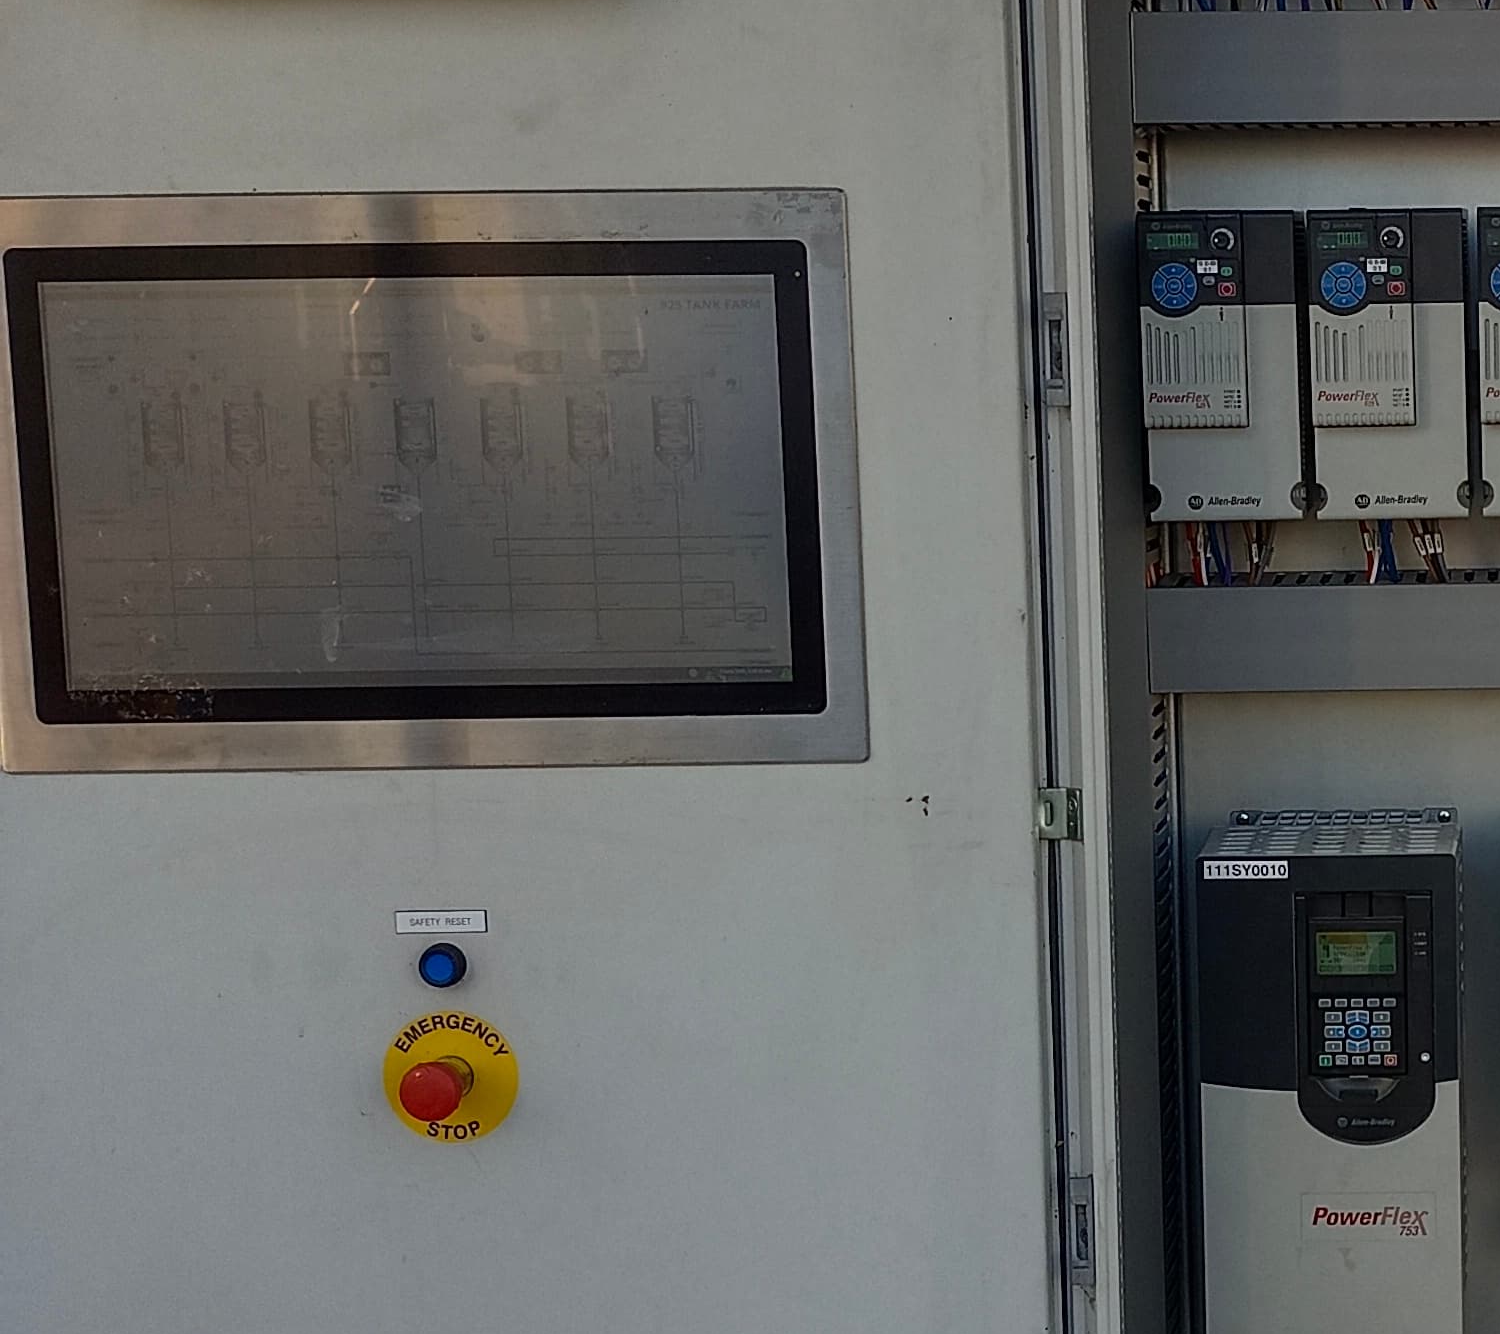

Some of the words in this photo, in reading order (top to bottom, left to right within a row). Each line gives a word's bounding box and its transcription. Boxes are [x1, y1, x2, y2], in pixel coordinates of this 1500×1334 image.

[1149, 392, 1211, 409] PowerFlex
[1318, 390, 1379, 407] PowerFlex
[1208, 496, 1262, 507] Allen-Bradley
[1375, 494, 1428, 505] Allen-Bradley
[1206, 864, 1287, 876] 111SY0010
[409, 917, 441, 927] SAFETY
[445, 917, 473, 926] RESET
[394, 1014, 509, 1056] EMERGENCY
[427, 1121, 481, 1140] STOP
[1313, 1206, 1429, 1236] PowerFlex
[1400, 1226, 1419, 1236] 753
